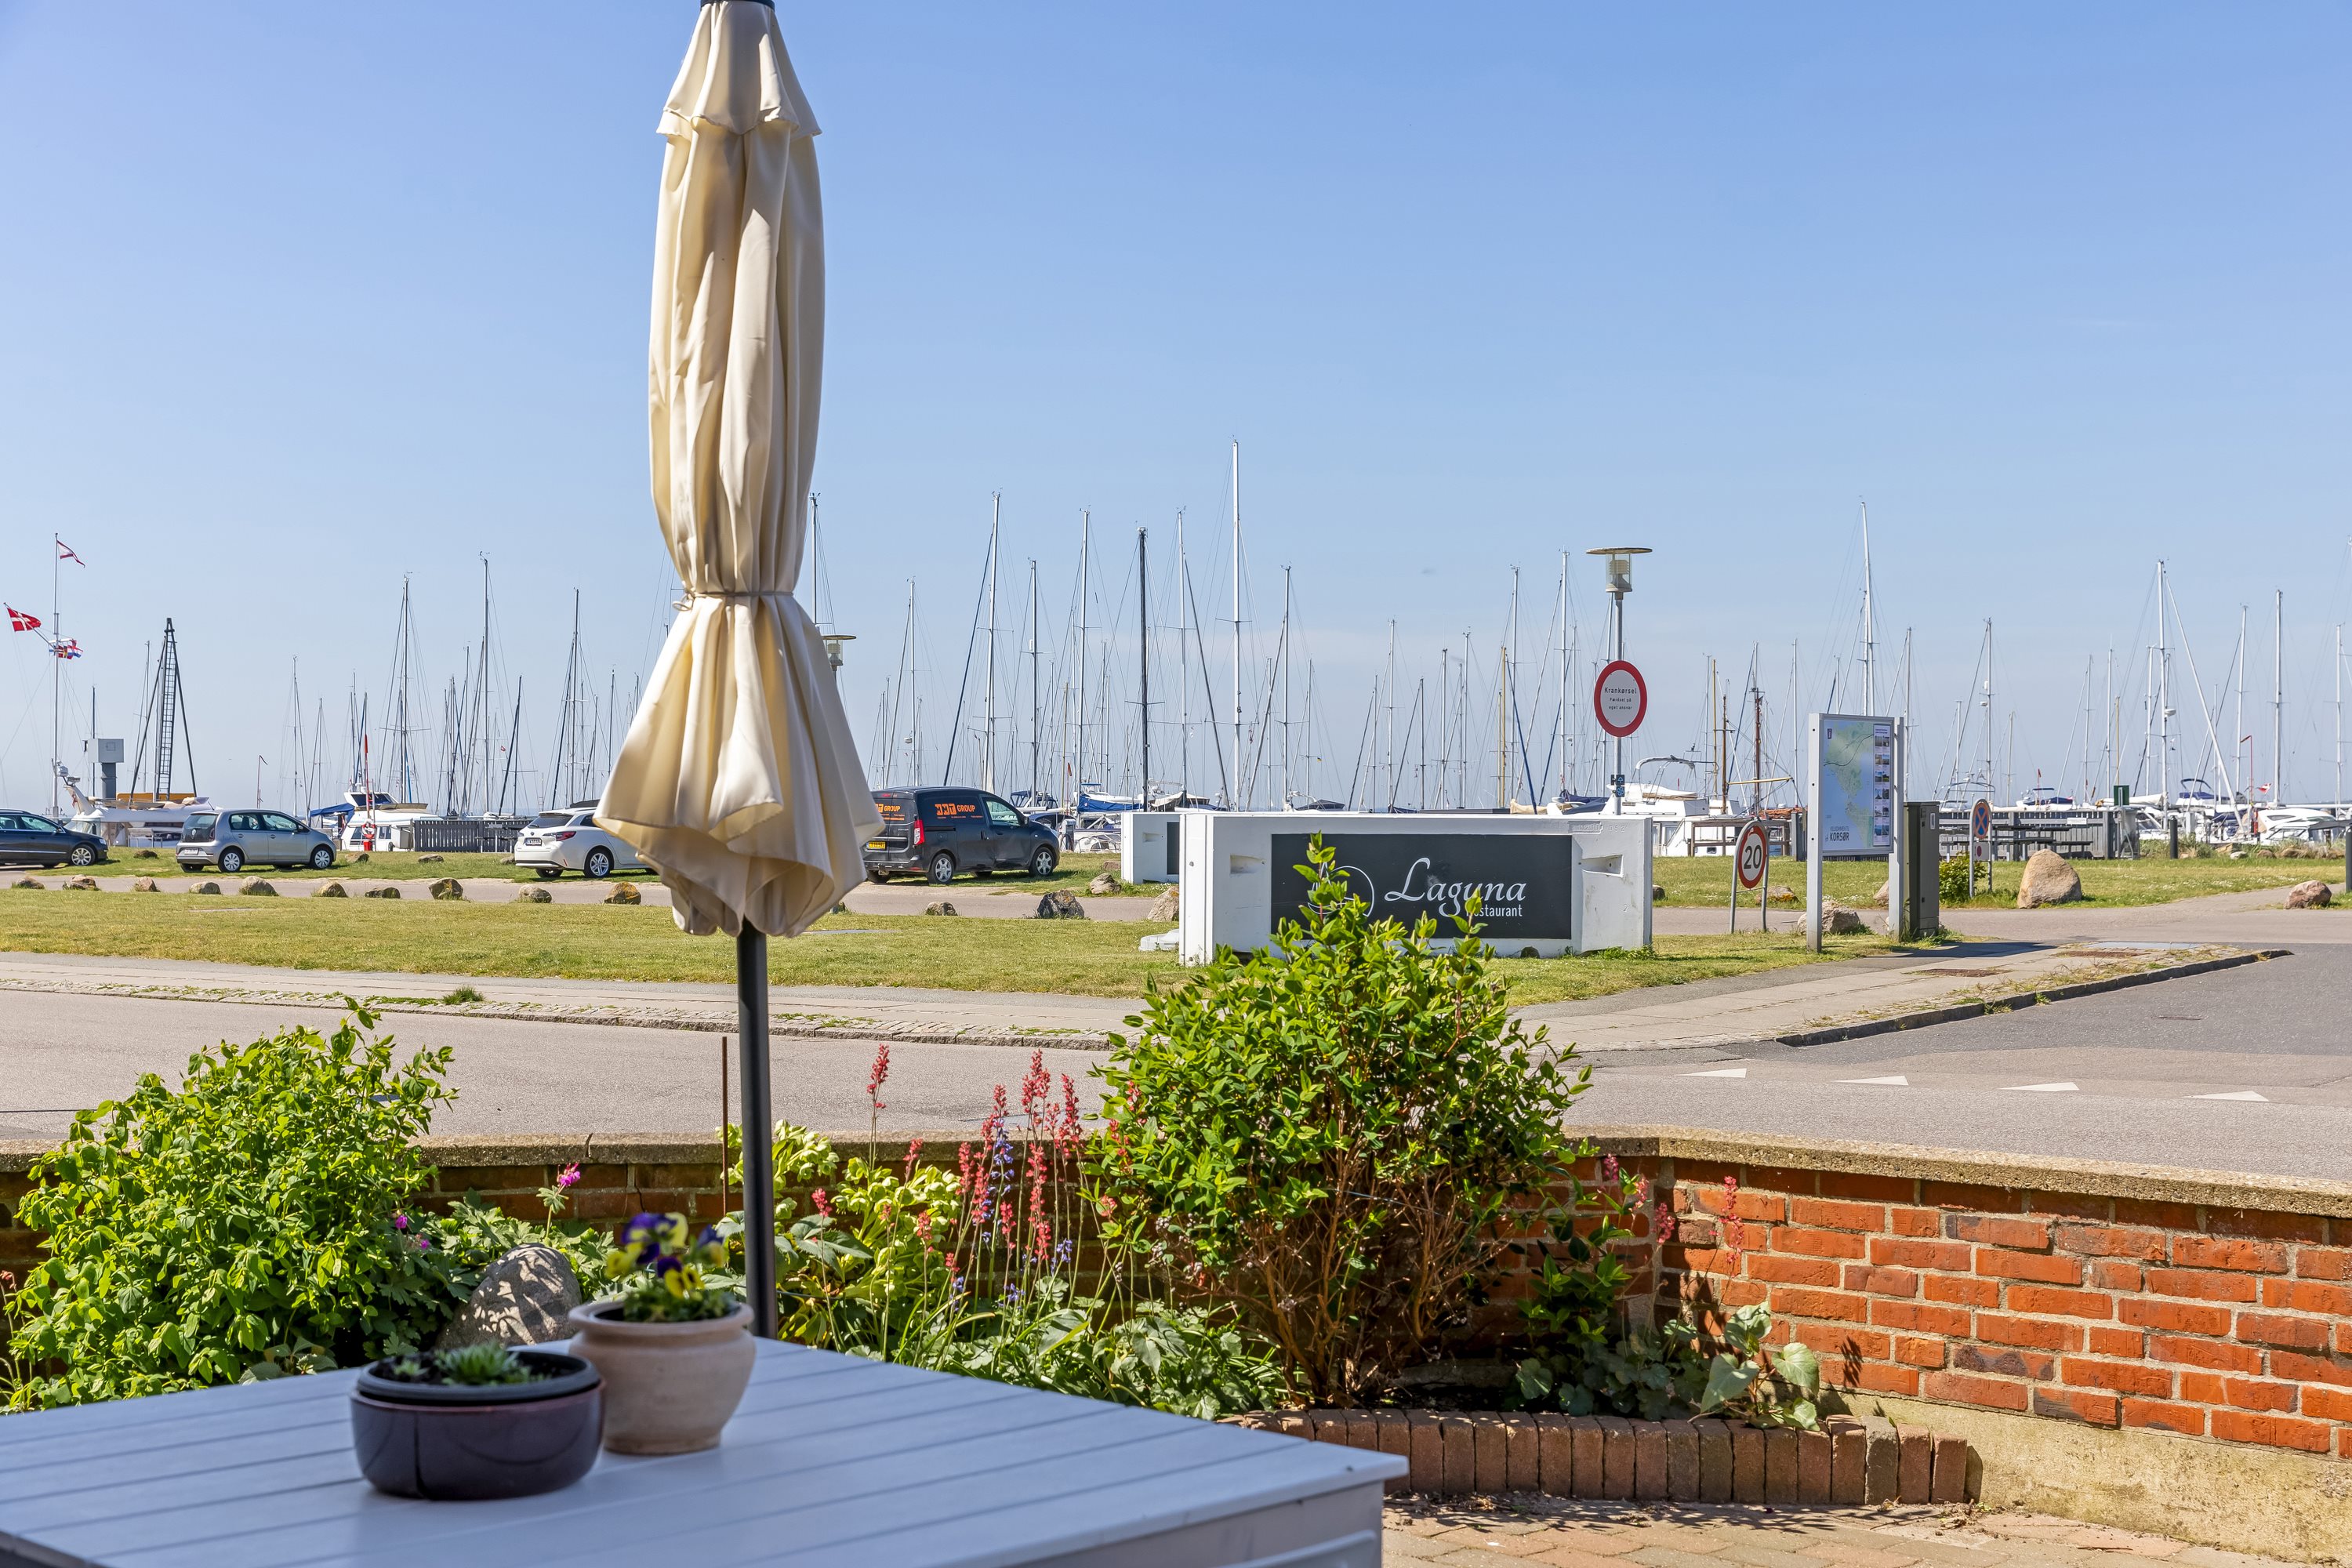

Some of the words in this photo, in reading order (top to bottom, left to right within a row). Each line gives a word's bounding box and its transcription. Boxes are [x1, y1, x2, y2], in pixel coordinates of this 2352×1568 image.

[1829, 832, 1849, 841] KORSØR
[1744, 845, 1762, 869] 20
[1384, 857, 1527, 917] Laguna
[1466, 904, 1523, 917] staurant
